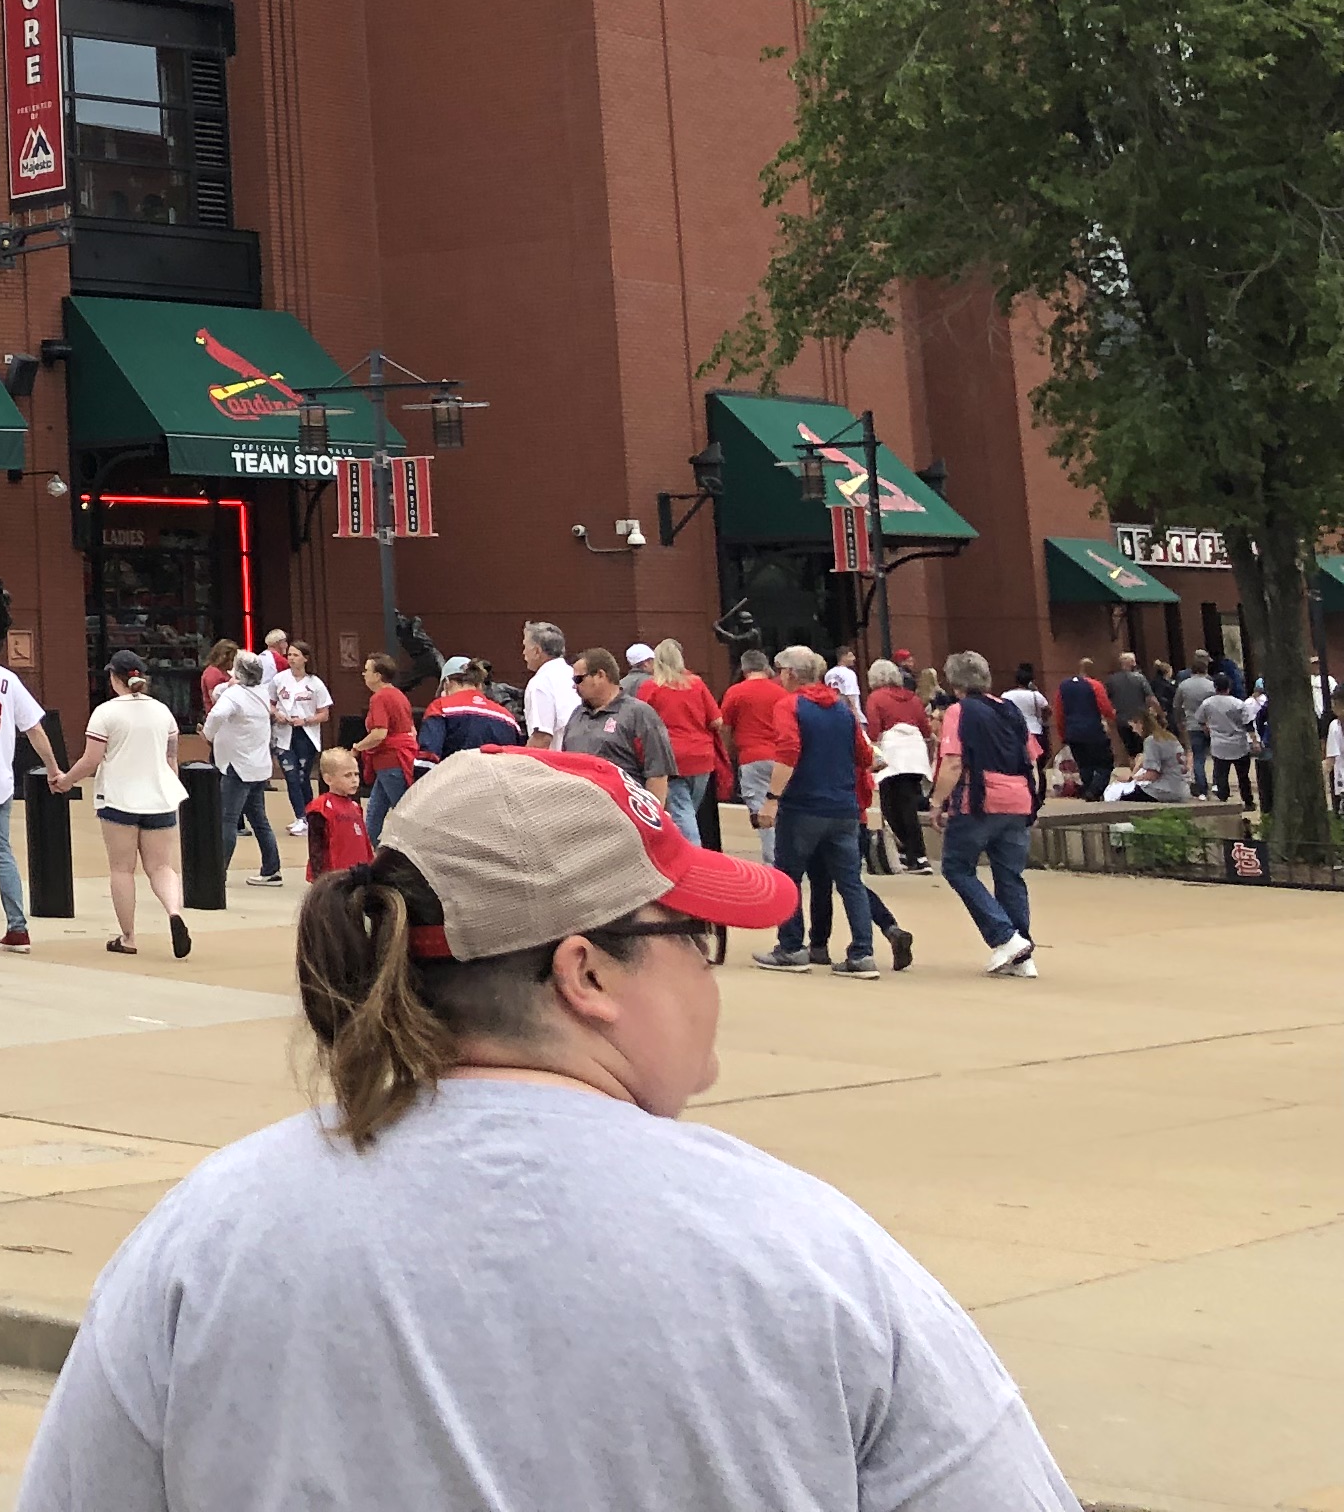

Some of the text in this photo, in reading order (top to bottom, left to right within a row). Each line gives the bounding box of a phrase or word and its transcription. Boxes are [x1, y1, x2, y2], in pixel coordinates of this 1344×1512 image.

[233, 443, 286, 453] OFFICIAL
[231, 452, 289, 474] TEAM
[102, 529, 145, 546] LADIES
